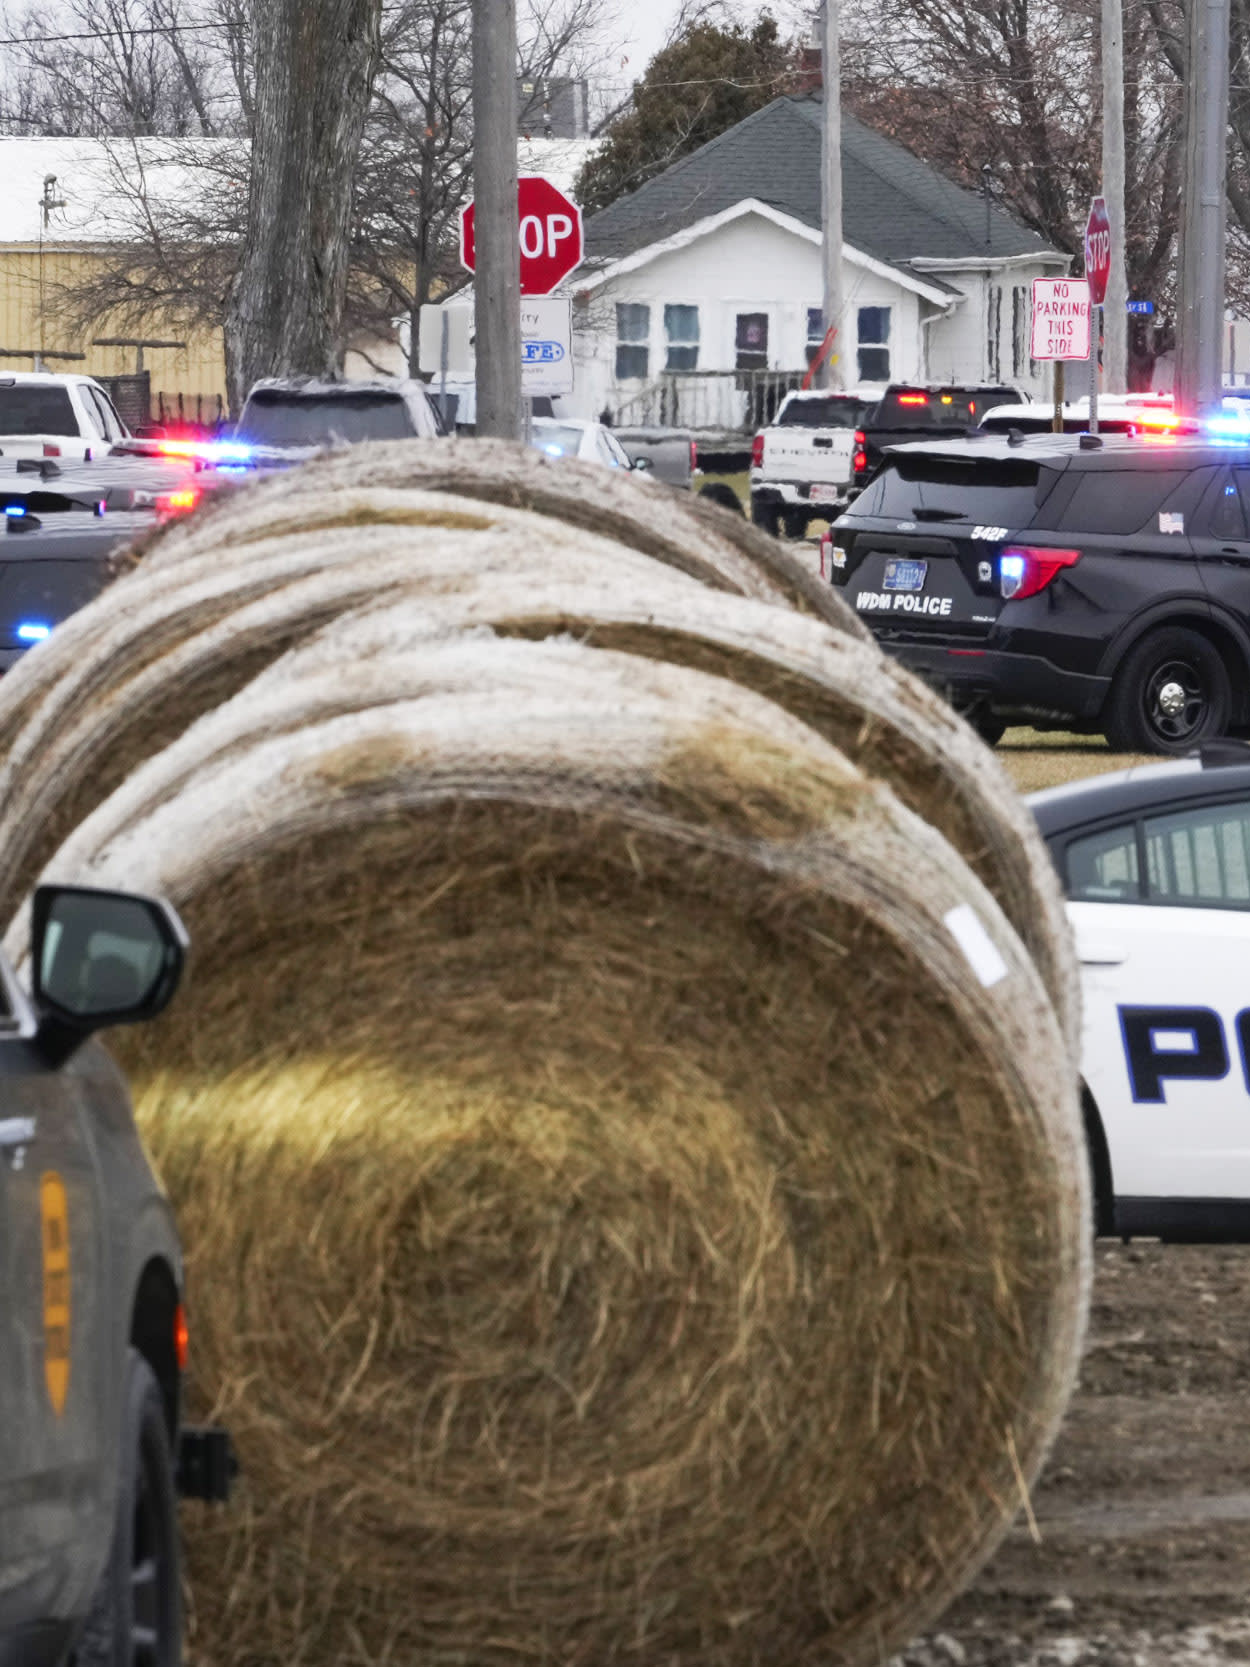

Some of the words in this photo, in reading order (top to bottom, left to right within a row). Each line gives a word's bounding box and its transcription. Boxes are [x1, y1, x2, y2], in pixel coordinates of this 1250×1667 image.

[518, 214, 573, 259] OP
[1087, 230, 1110, 273] STOP
[1053, 284, 1069, 298] NO
[1037, 301, 1088, 316] PARKING
[1047, 320, 1073, 335] THIS
[1047, 339, 1073, 354] SIDE
[856, 591, 892, 610] WDM
[893, 593, 953, 616] POLICE
